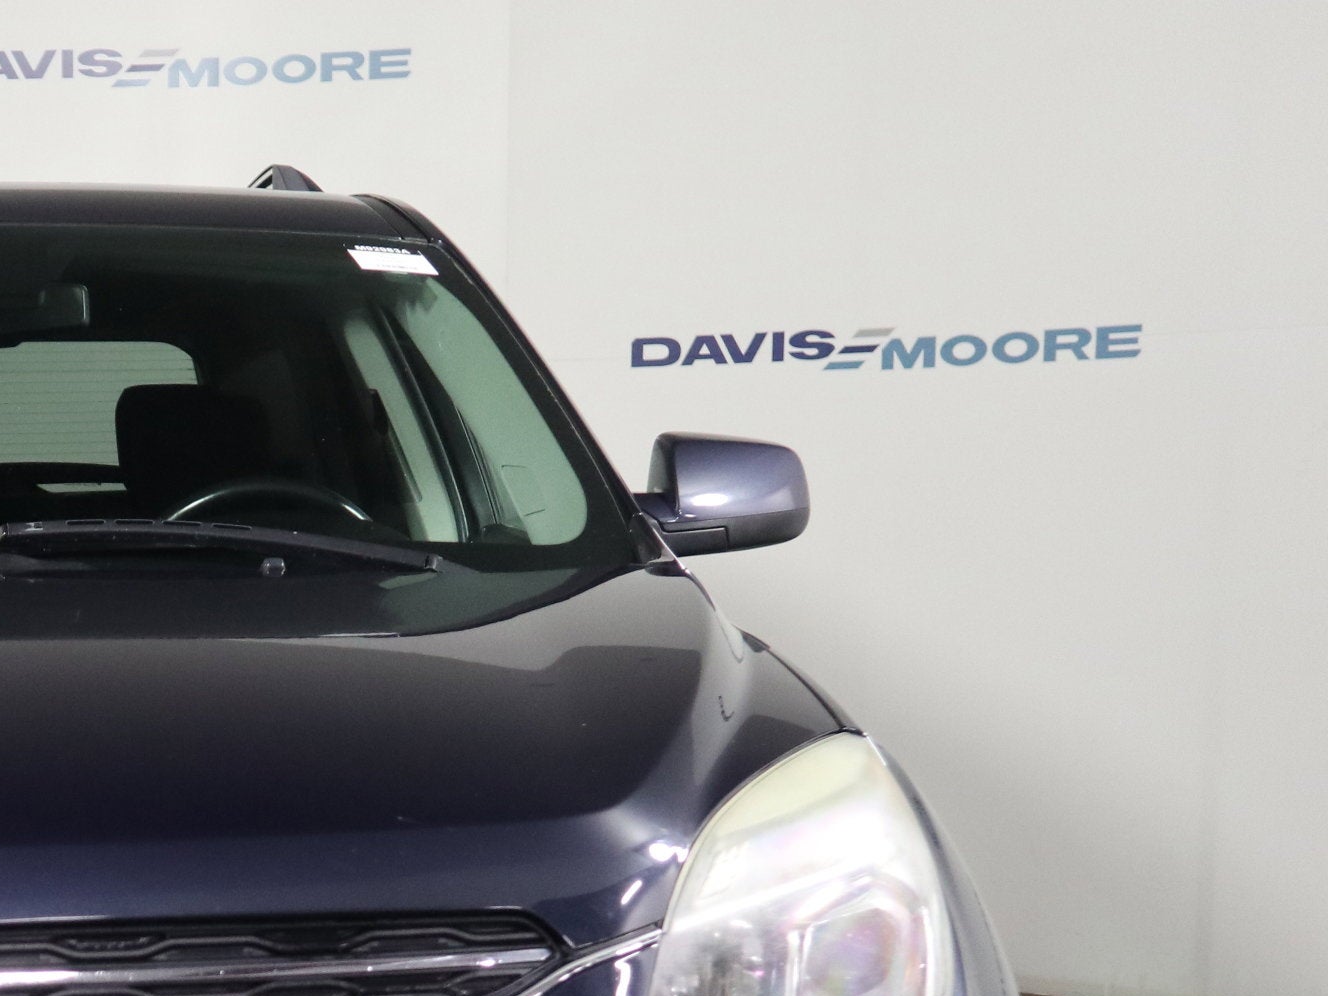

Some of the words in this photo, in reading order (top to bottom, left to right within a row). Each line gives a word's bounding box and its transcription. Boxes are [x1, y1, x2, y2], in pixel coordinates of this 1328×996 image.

[168, 47, 412, 88] MOORE
[630, 330, 837, 368] DAVIS
[880, 323, 1143, 371] MOORE
